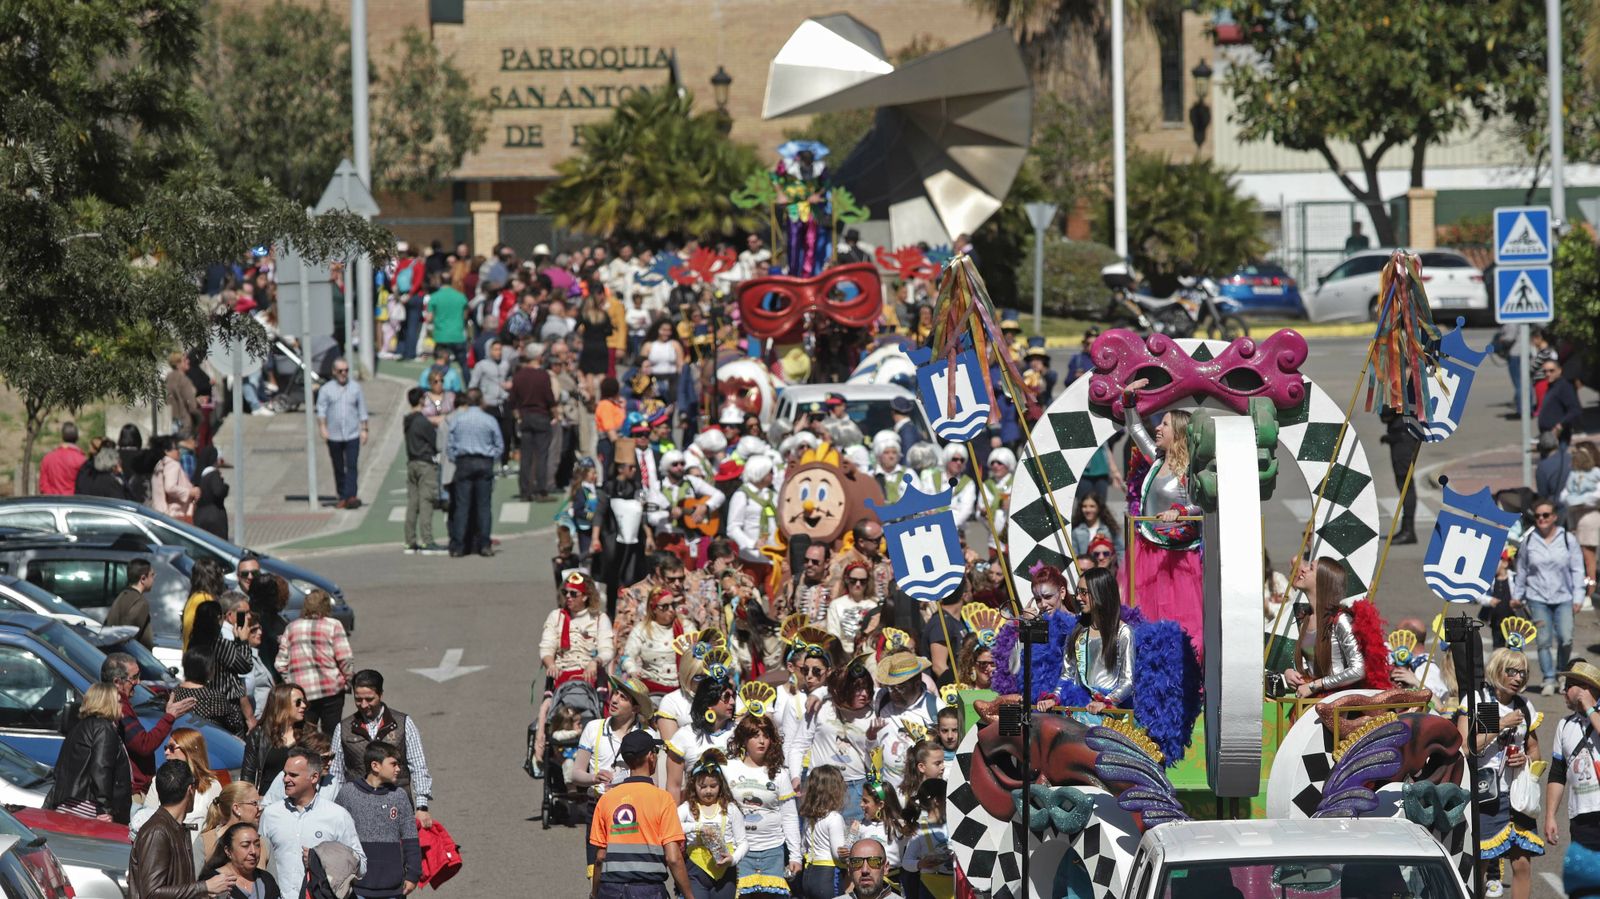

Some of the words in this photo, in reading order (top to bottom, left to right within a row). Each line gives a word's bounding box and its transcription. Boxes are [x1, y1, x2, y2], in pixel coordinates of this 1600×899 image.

[501, 46, 671, 71] PARROQUIA
[490, 86, 546, 108] SAN
[504, 124, 544, 148] DE
[390, 807, 398, 819] 8
